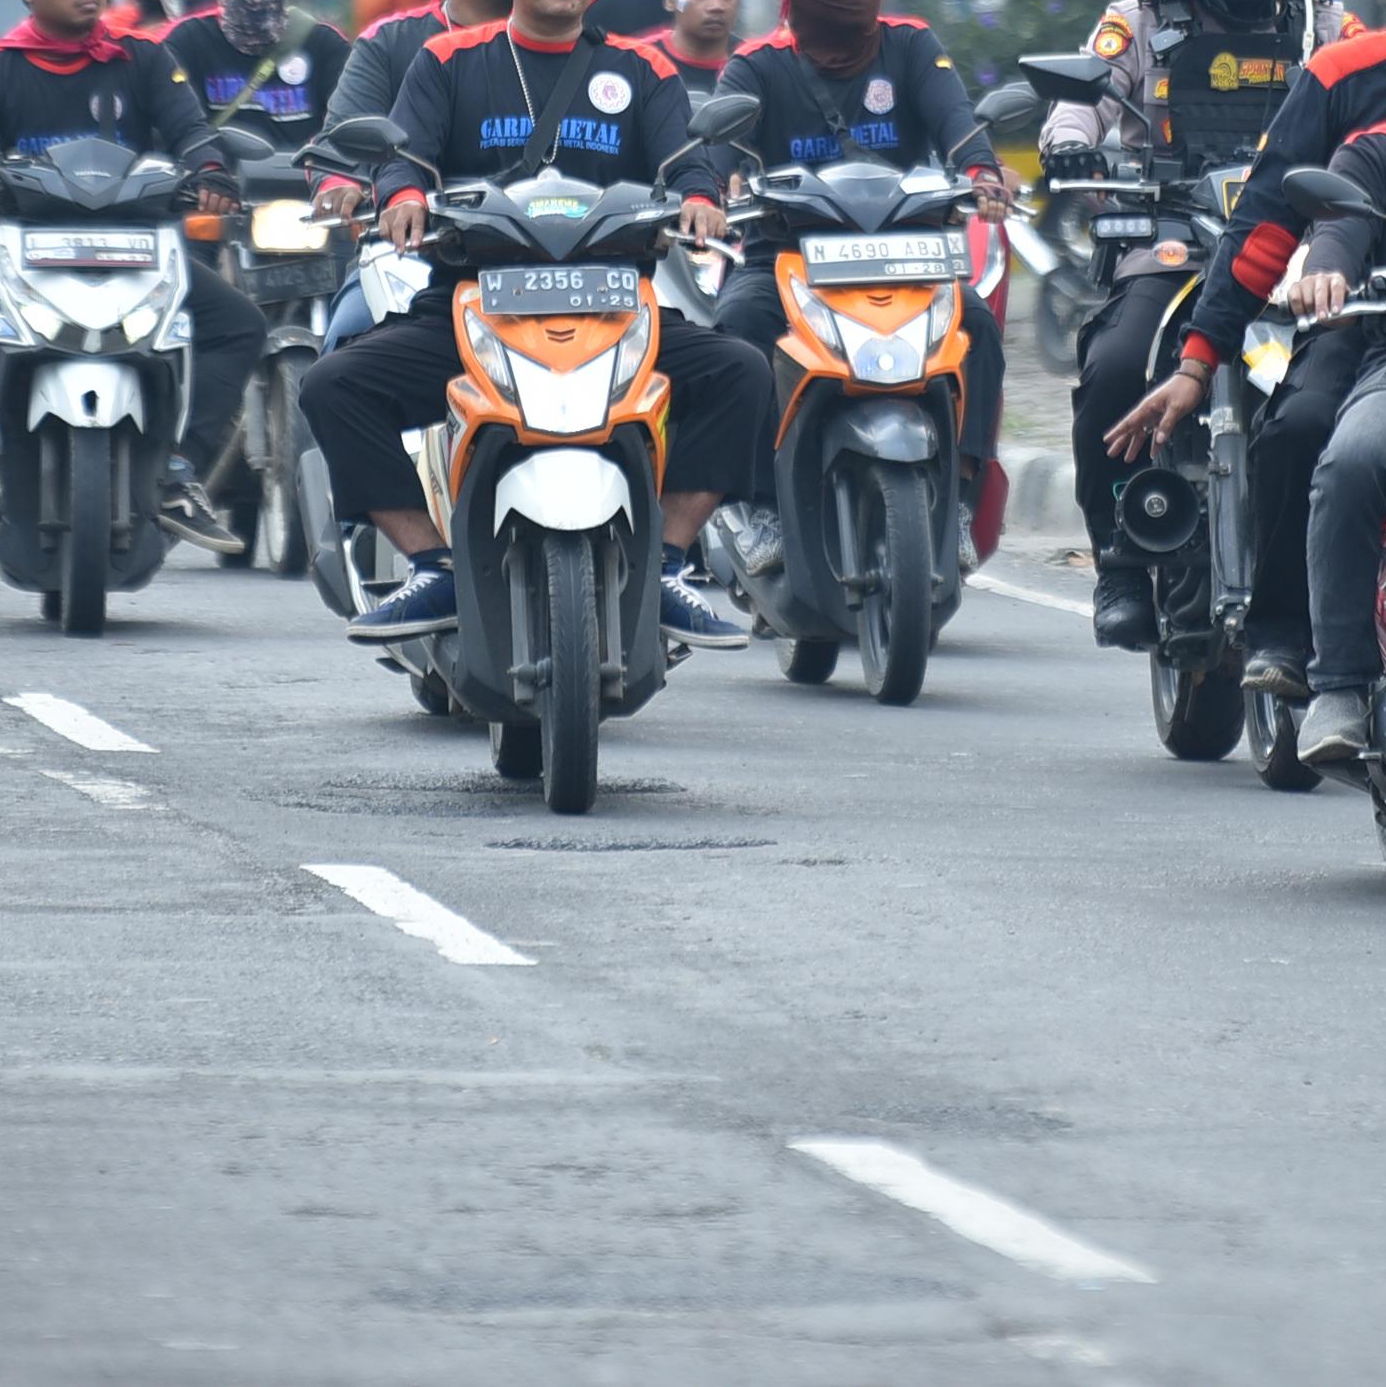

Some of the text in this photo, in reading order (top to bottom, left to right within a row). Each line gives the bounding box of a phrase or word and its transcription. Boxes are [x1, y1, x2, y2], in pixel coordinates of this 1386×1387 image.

[839, 242, 890, 260] 4690
[904, 241, 942, 257] ABJ
[486, 273, 502, 292] W
[524, 270, 584, 291] 2356
